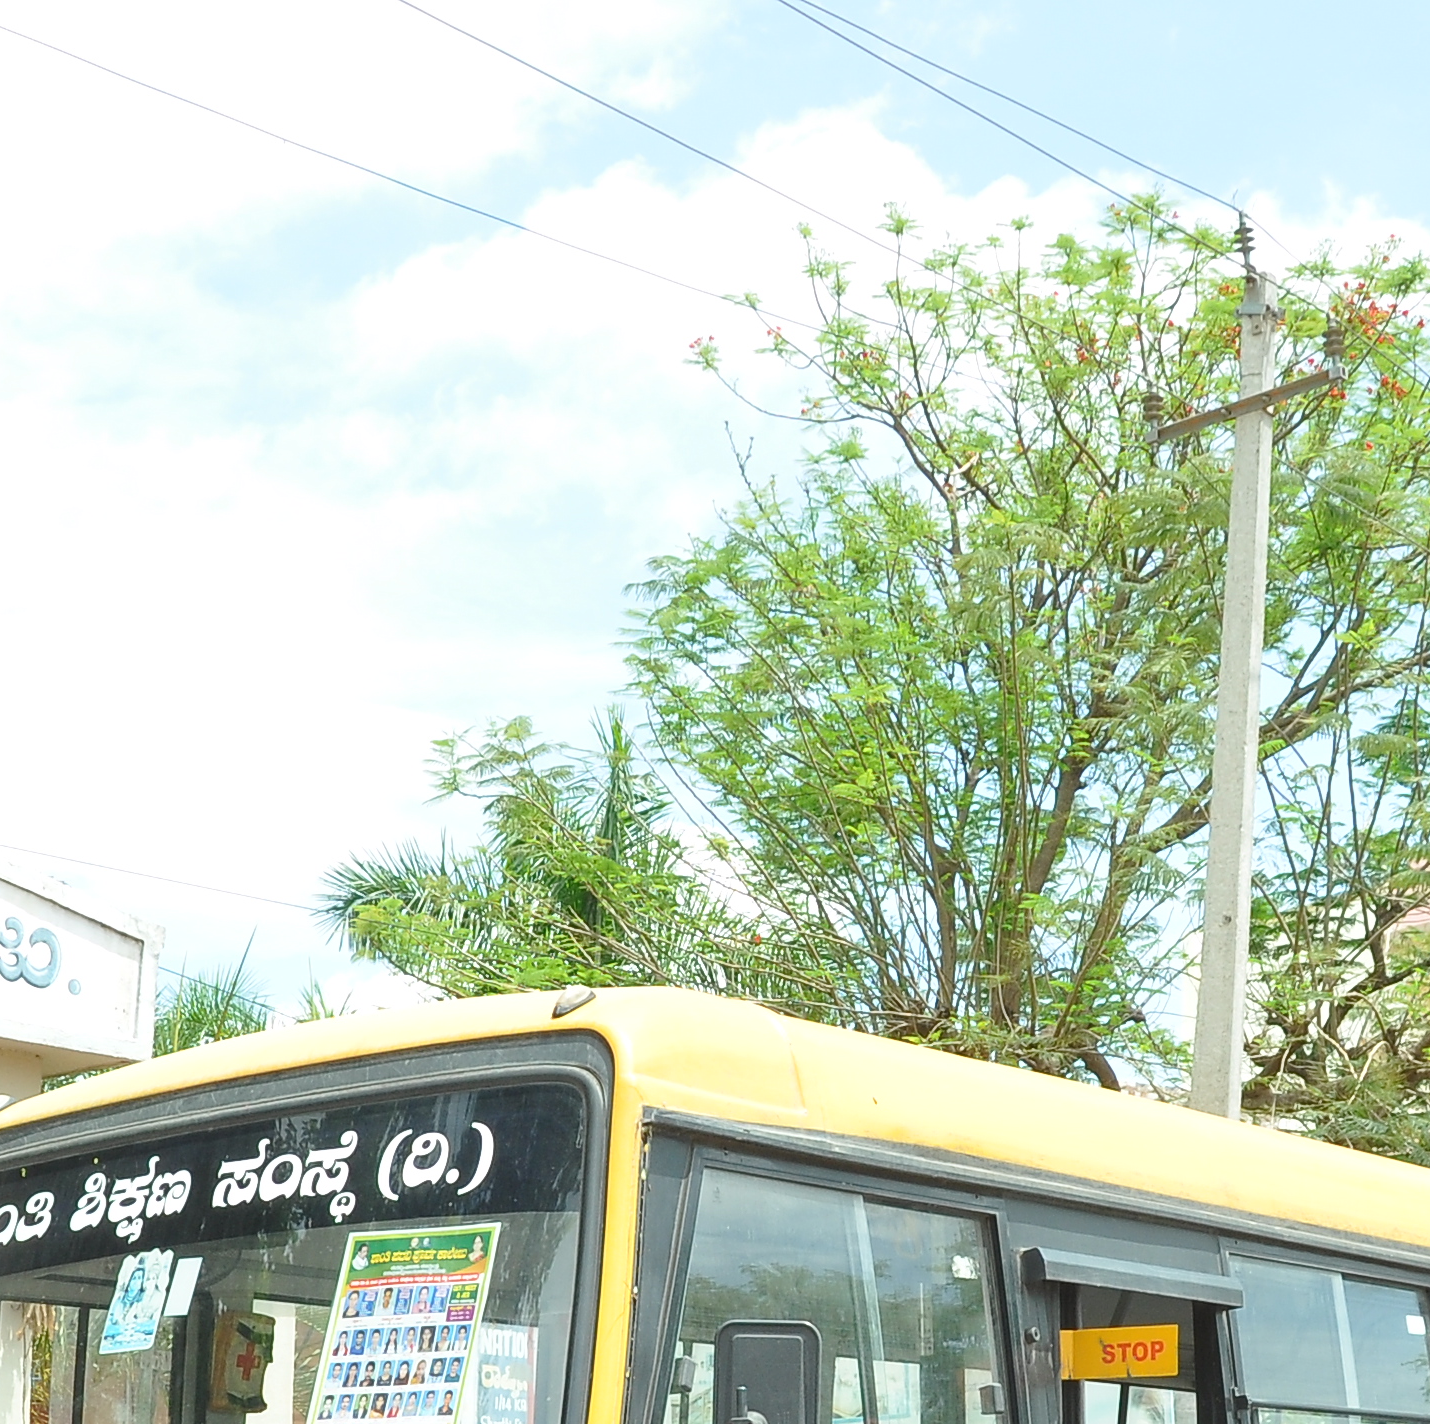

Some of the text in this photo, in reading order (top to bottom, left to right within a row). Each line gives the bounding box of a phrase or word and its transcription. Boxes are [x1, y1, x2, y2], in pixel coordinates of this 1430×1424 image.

[69, 1155, 192, 1245] ಶಿಕ್ಷಣ
[213, 1129, 360, 1224] ಸಂಸ್ಥೆ
[376, 1121, 494, 1201] (ರಿ.)
[1101, 1340, 1165, 1365] STOP
